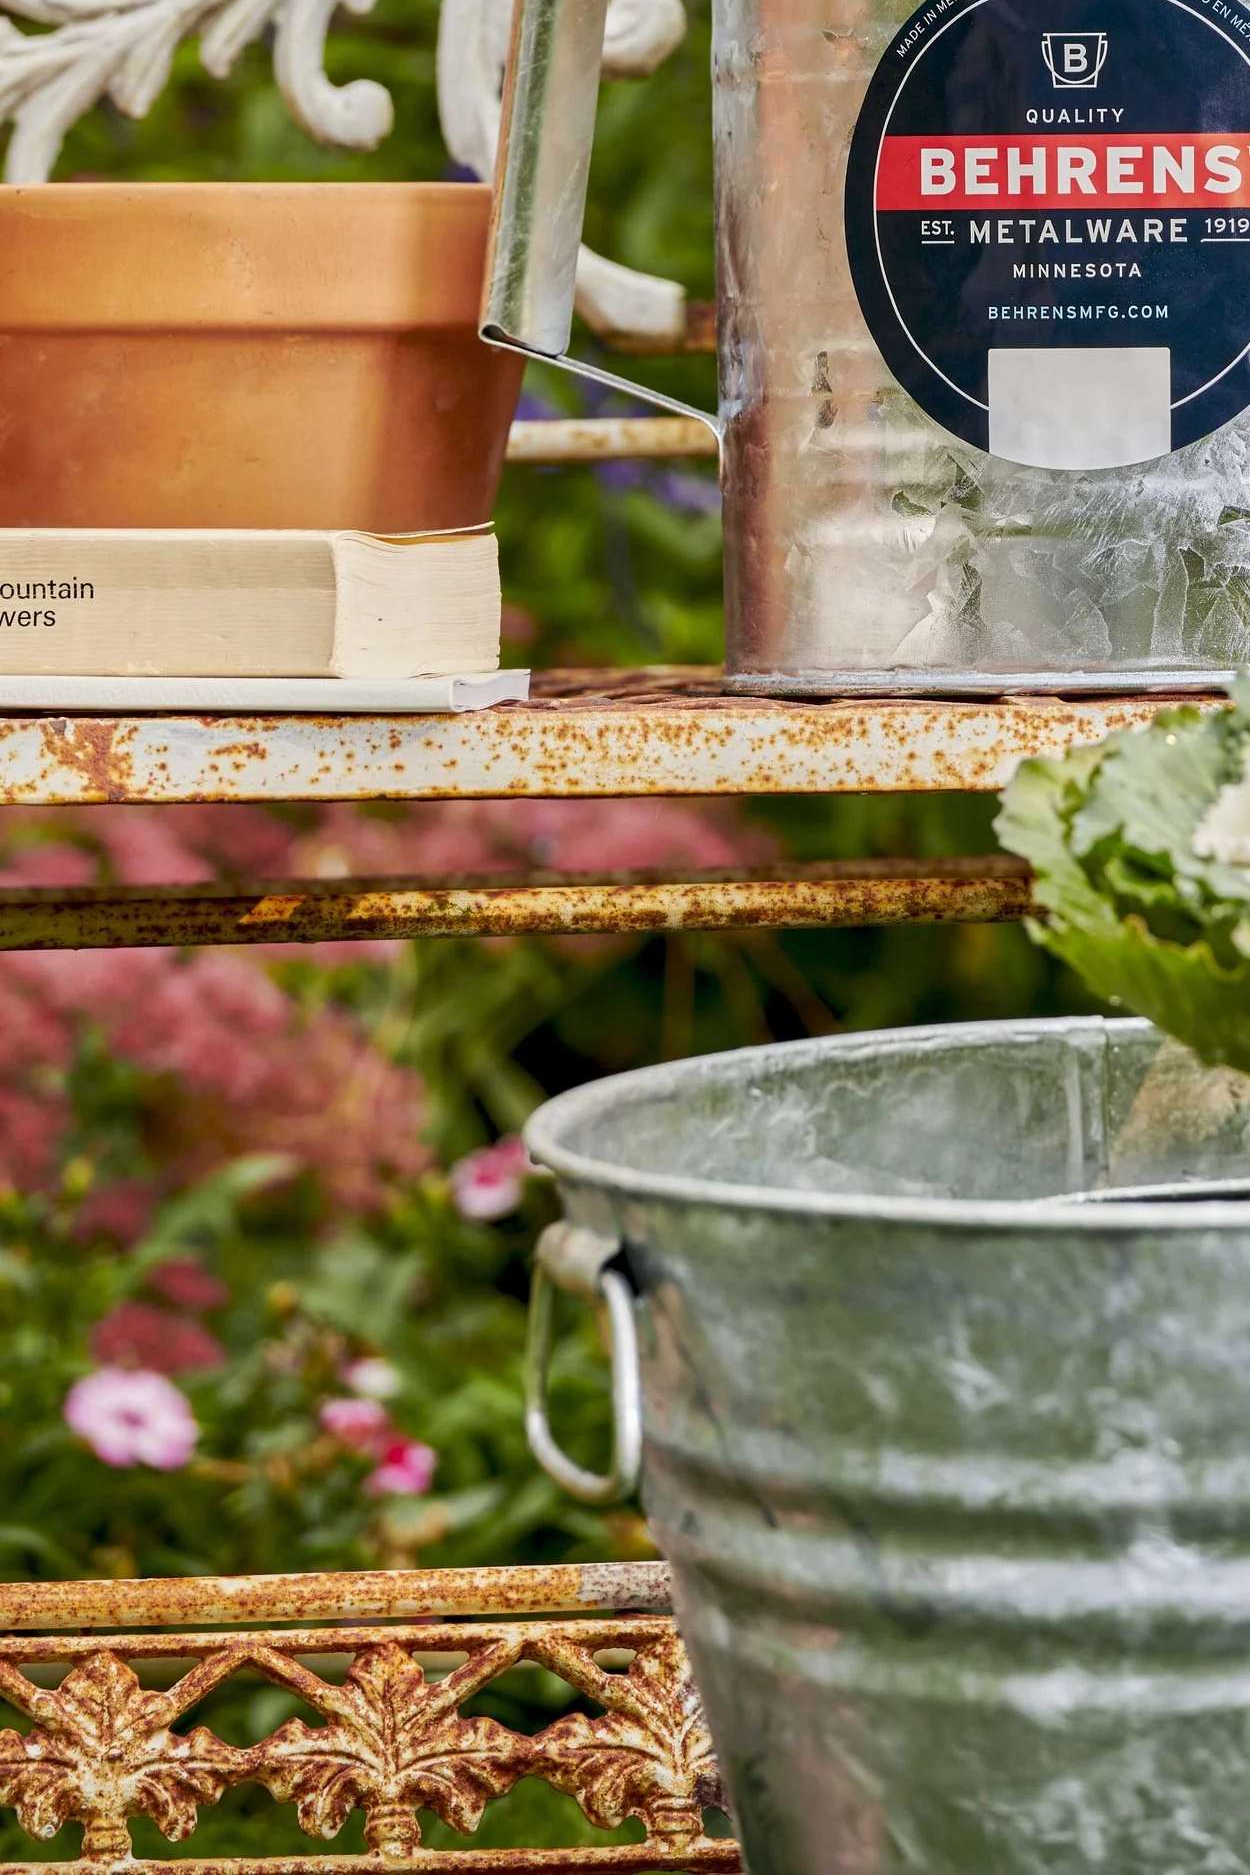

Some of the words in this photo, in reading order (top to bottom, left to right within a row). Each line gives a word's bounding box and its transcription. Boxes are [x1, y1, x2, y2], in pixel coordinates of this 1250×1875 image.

[896, 23, 926, 58] MADE
[923, 9, 938, 25] IN
[1211, 0, 1233, 19] EN
[1063, 43, 1088, 73] B
[1026, 107, 1125, 124] QUALITY
[921, 219, 956, 236] EST.
[970, 218, 1189, 244] METALWARE
[1205, 217, 1250, 234] 1919
[1012, 262, 1143, 279] MINNESOTA
[987, 304, 1169, 320] BEHRENSMFG.COM
